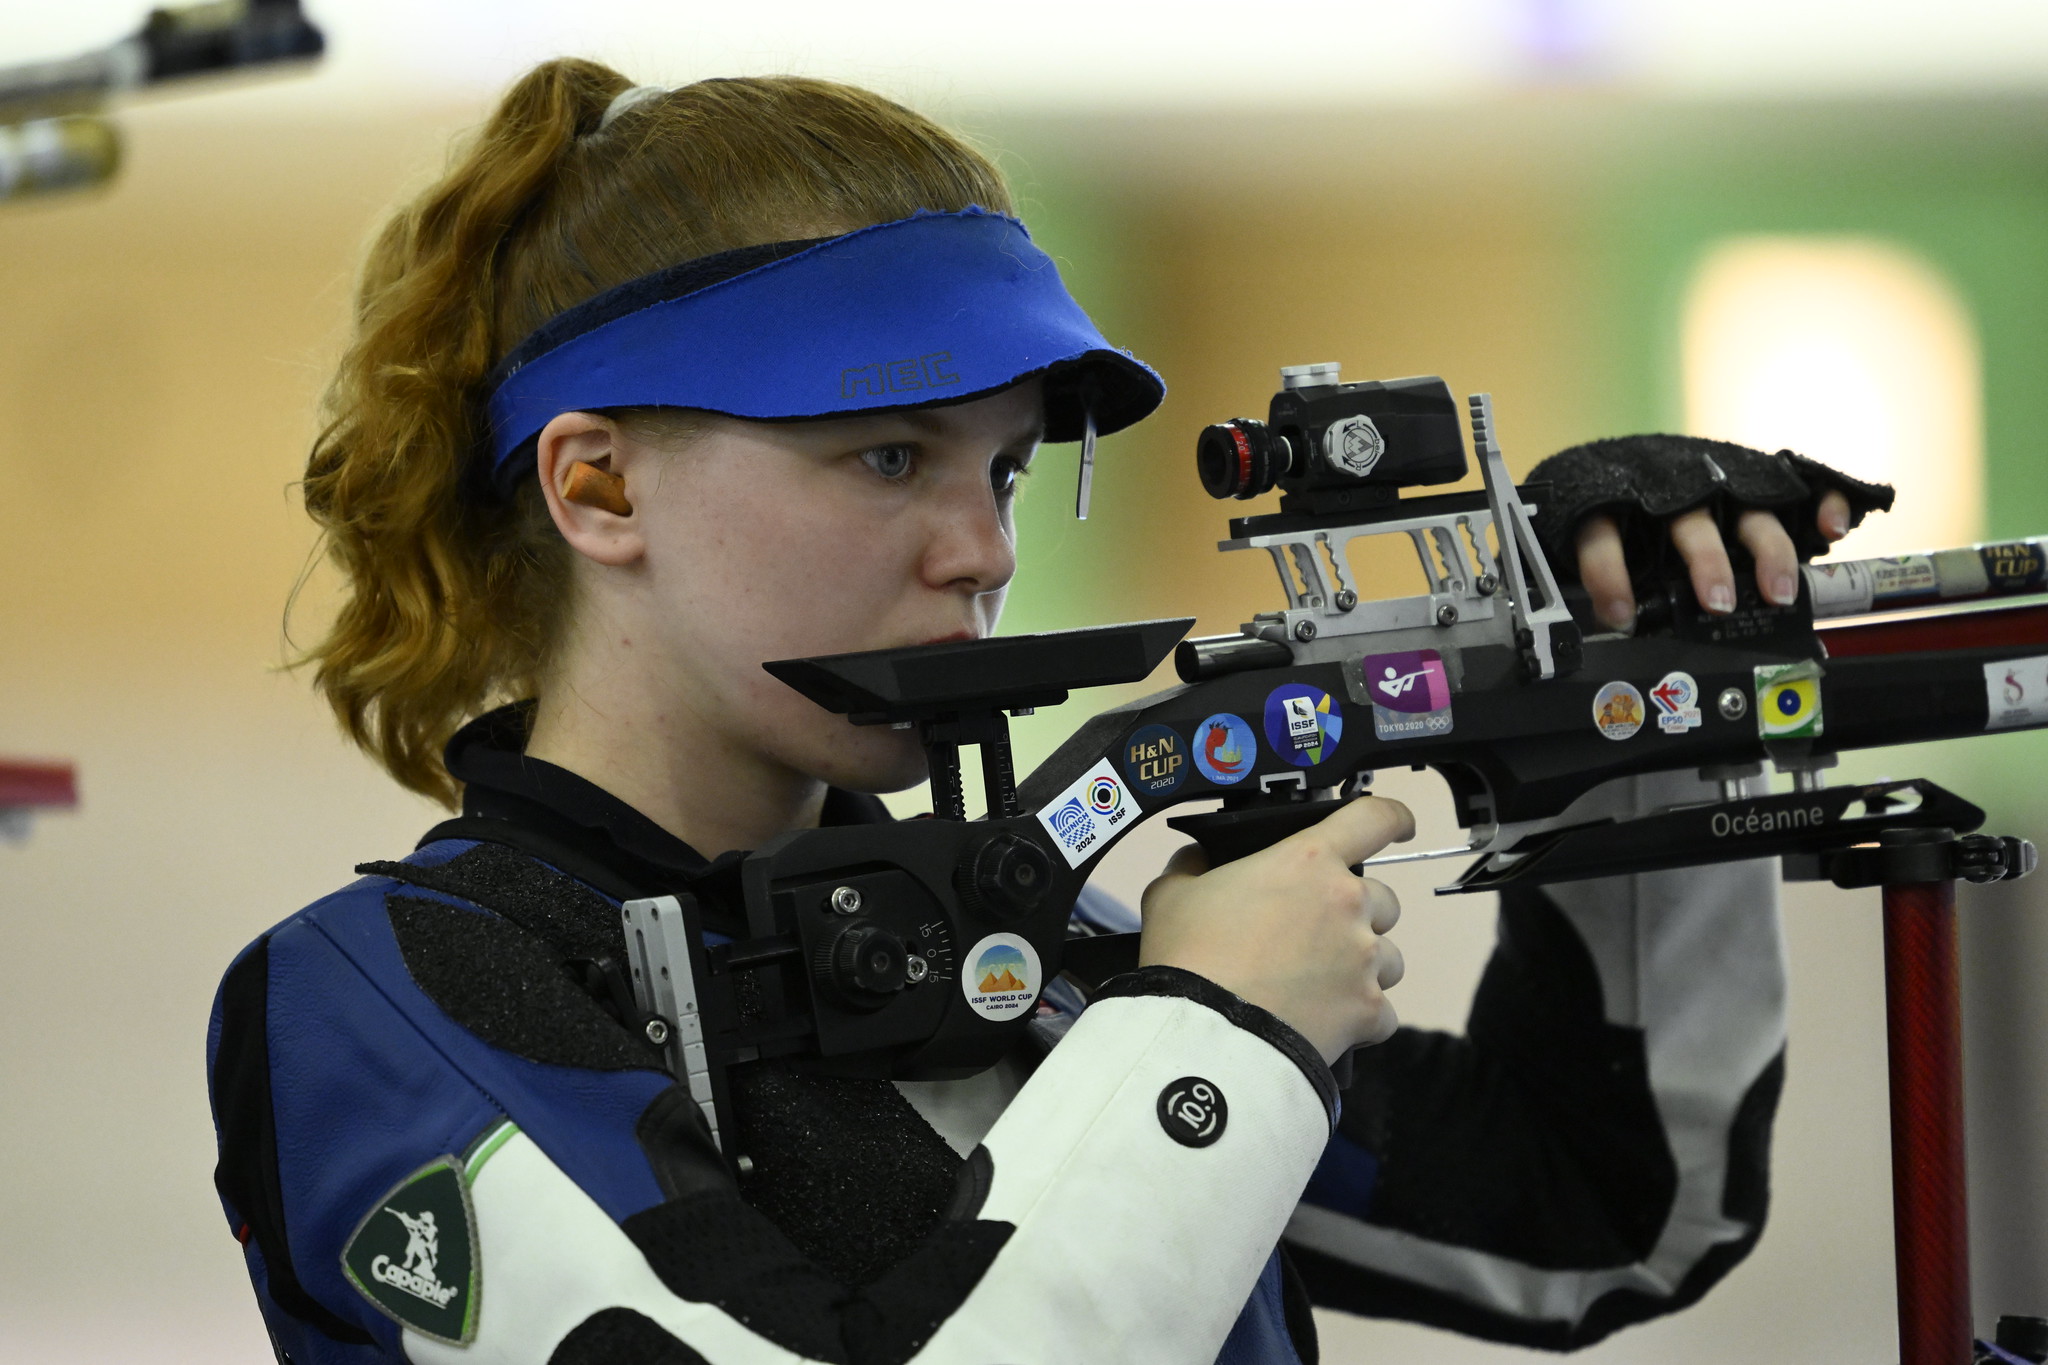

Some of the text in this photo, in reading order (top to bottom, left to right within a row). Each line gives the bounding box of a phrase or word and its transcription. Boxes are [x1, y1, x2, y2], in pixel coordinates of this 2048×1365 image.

[841, 351, 960, 399] MEC
[1995, 559, 2038, 577] CUP
[1291, 719, 1315, 730] ISSF
[1379, 721, 1424, 733] TOKYO 2020
[1661, 715, 1684, 725] EPSO
[1130, 736, 1174, 763] H&N
[1140, 754, 1183, 781] CUP
[1150, 777, 1175, 790] 2020
[1059, 812, 1089, 839] MUNICH
[1108, 807, 1127, 826] ISSF
[1711, 806, 1824, 837] Océanne
[1075, 833, 1097, 853] 2024
[919, 923, 932, 938] 15
[928, 970, 939, 983] 15
[989, 994, 1016, 1002] WORLD
